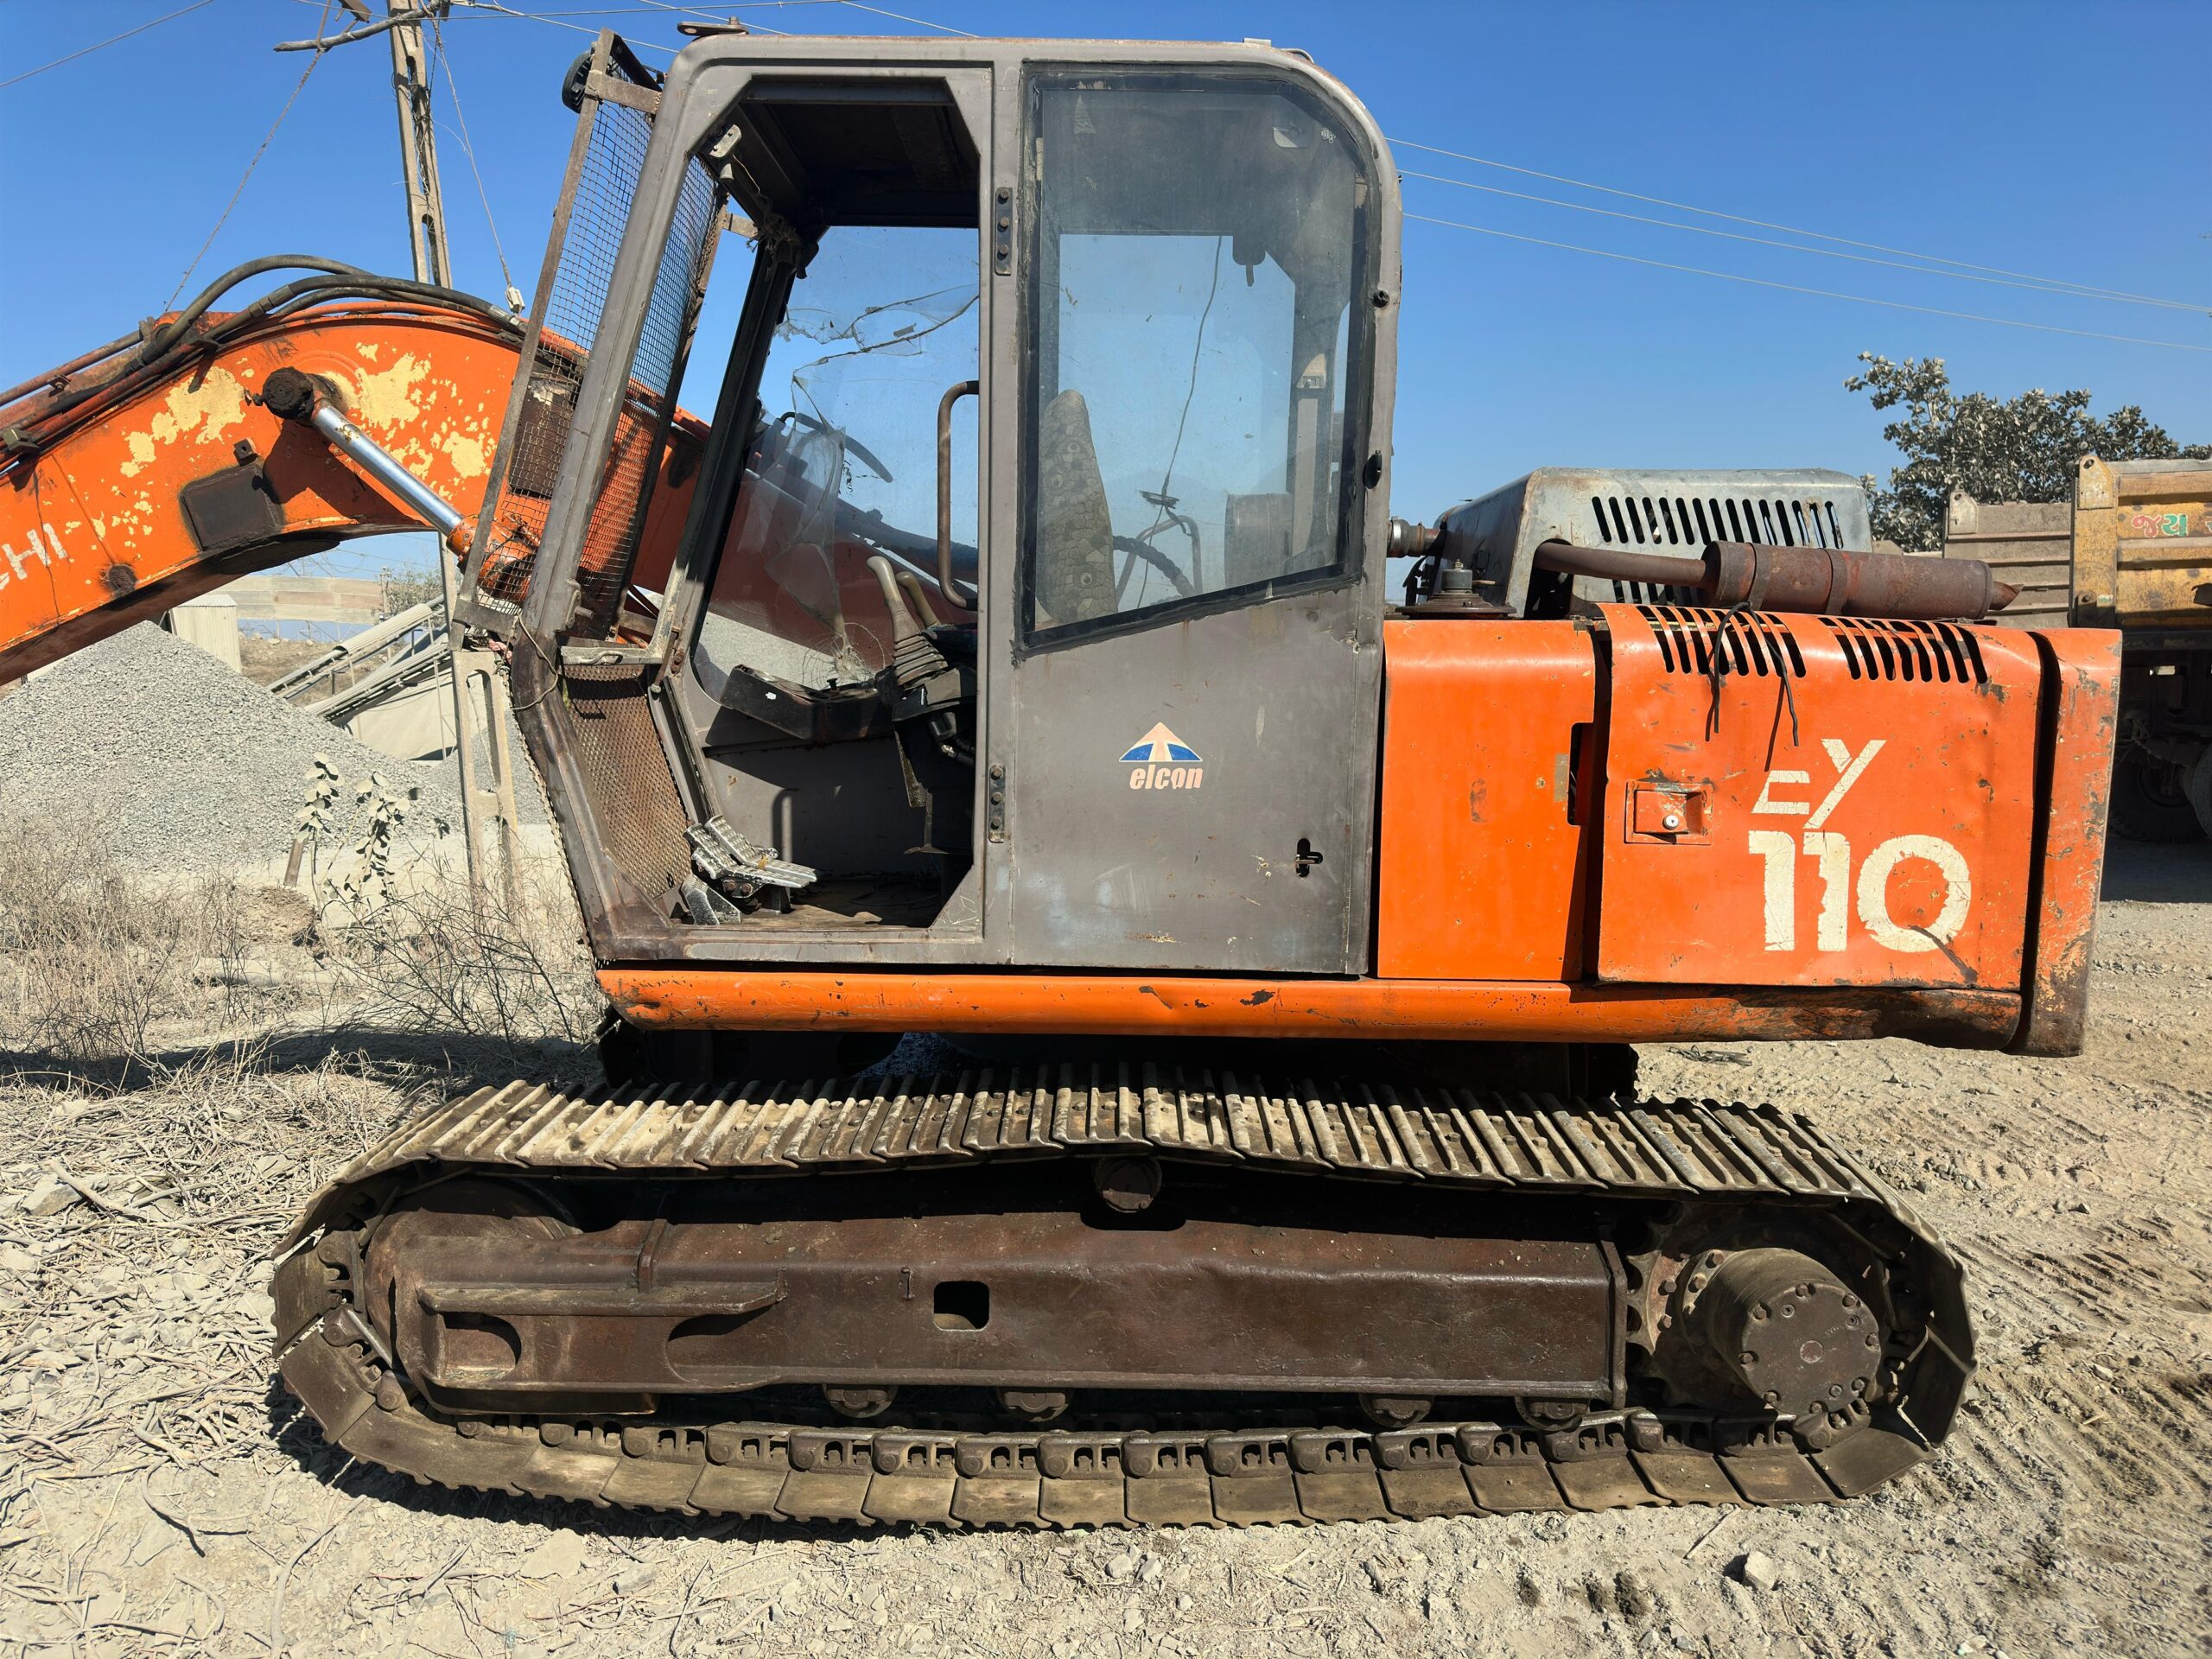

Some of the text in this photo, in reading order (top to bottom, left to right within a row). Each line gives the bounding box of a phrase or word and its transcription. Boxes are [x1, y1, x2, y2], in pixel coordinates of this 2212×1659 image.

[0, 523, 70, 590] HI
[1129, 764, 1204, 790] elcon
[1749, 830, 1971, 953] 110
